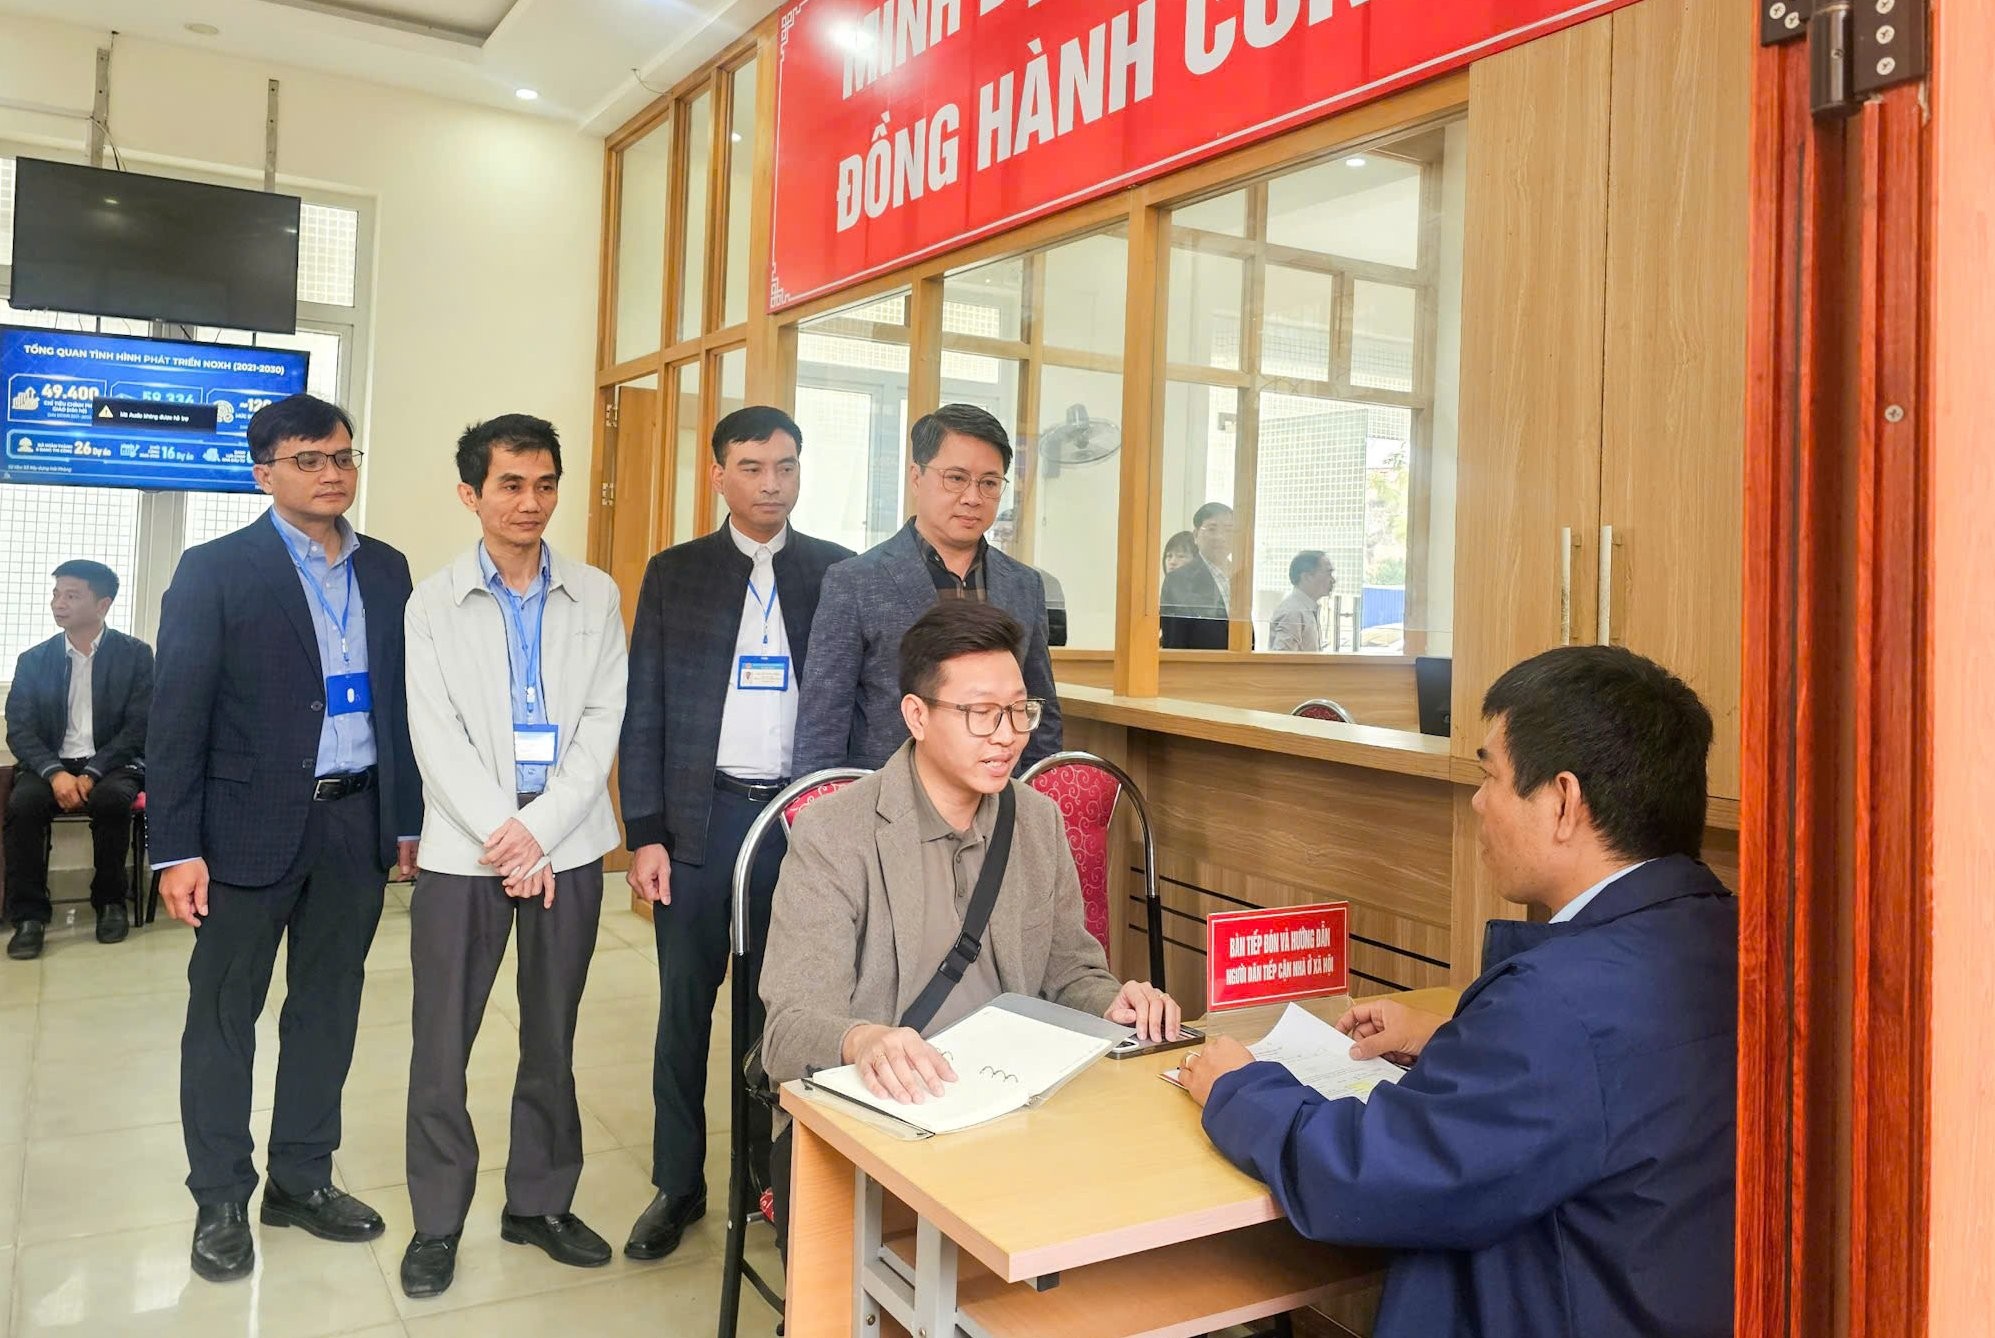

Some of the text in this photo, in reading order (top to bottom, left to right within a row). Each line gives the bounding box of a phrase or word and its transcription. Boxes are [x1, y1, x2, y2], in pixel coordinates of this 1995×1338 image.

[842, 0, 961, 100] MINH
[836, 103, 960, 233] ĐỒNG
[977, 0, 1156, 171] HÀNH
[24, 343, 285, 376] TỔNG QUAN TÌNH HÌNH PHÁT TRIỂN NOXH (2021-2030)
[74, 441, 92, 455] 26
[161, 446, 175, 459] 16
[1229, 920, 1331, 958] BÀN TIẾP ĐÓN VÀ HƯỚNG DẪN
[1226, 963, 1247, 986] NGƯỜI
[1247, 962, 1262, 983] DÂN
[1263, 958, 1277, 981] TIẾP
[1278, 958, 1292, 982] CẬN
[1292, 956, 1307, 977] NHÀ
[1322, 953, 1334, 977] HỘI
